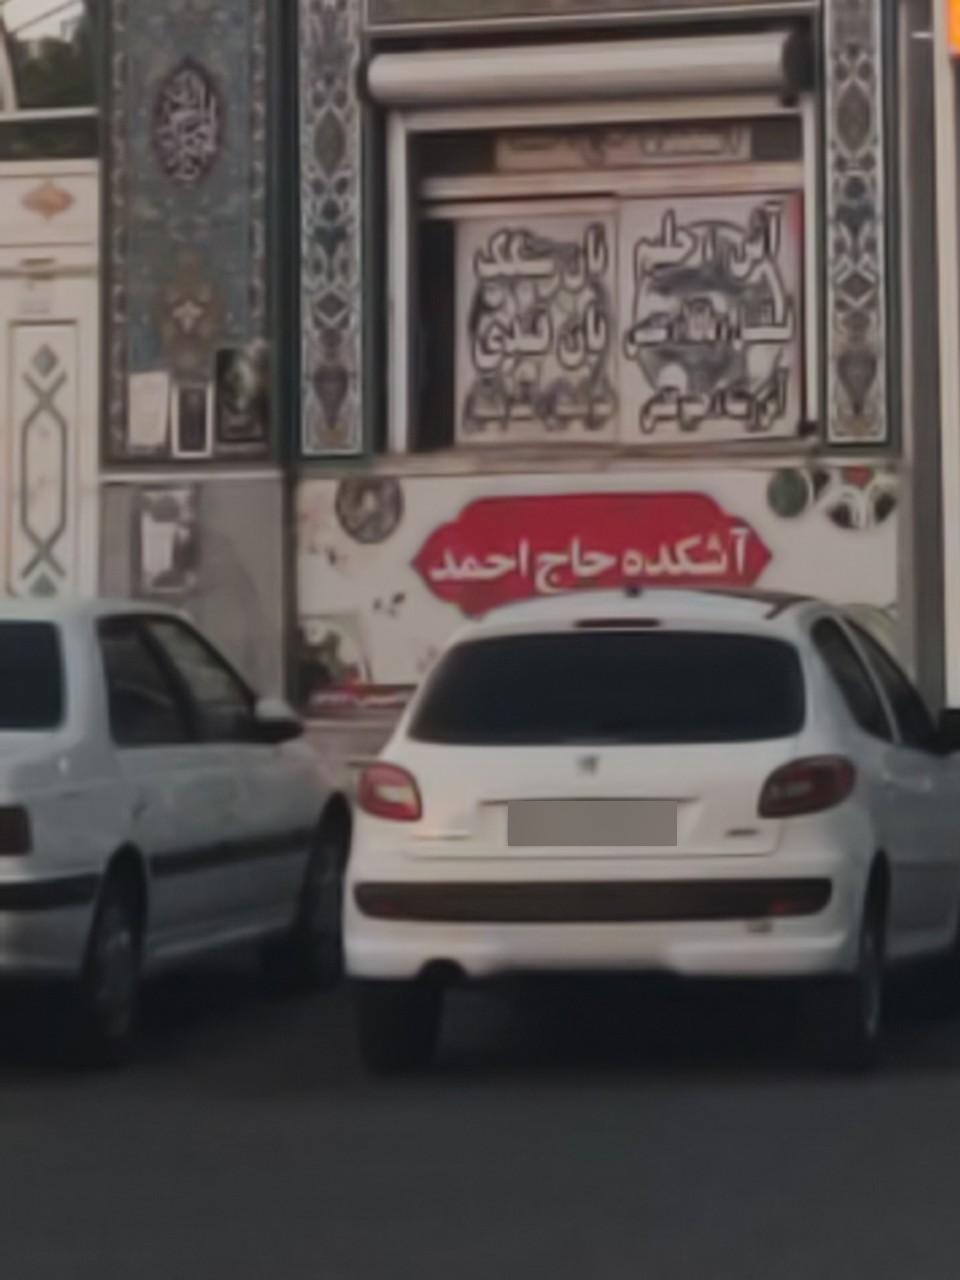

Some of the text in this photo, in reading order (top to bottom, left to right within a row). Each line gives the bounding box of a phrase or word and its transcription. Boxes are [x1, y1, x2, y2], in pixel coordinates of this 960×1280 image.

[429, 526, 749, 594] آشکده حاج احمد
